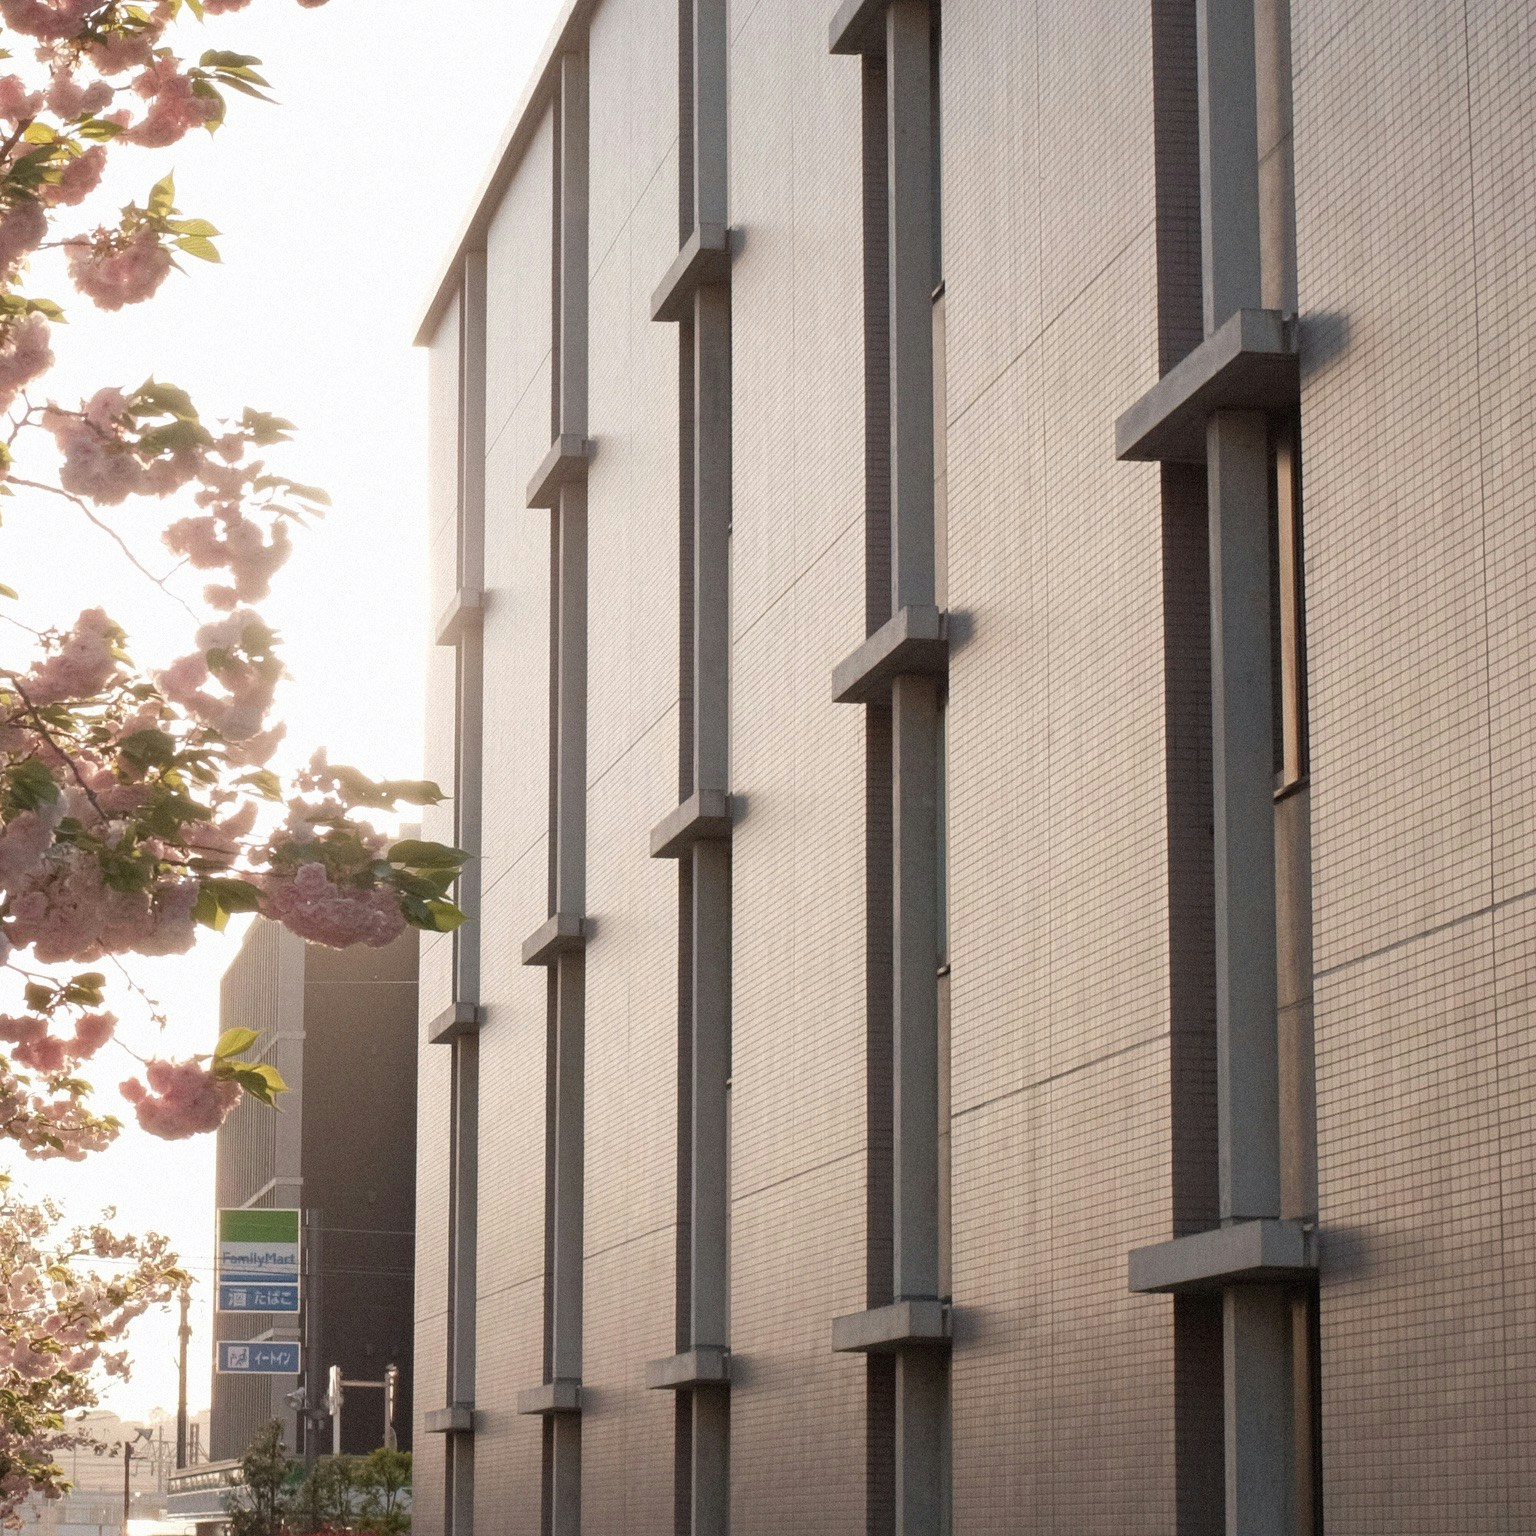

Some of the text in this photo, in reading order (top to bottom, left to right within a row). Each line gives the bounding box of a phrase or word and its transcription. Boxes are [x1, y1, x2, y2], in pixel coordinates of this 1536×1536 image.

[223, 1252, 295, 1267] FamilyMart
[229, 1289, 292, 1306] 酒 たばこ
[254, 1351, 291, 1365] イートイン
